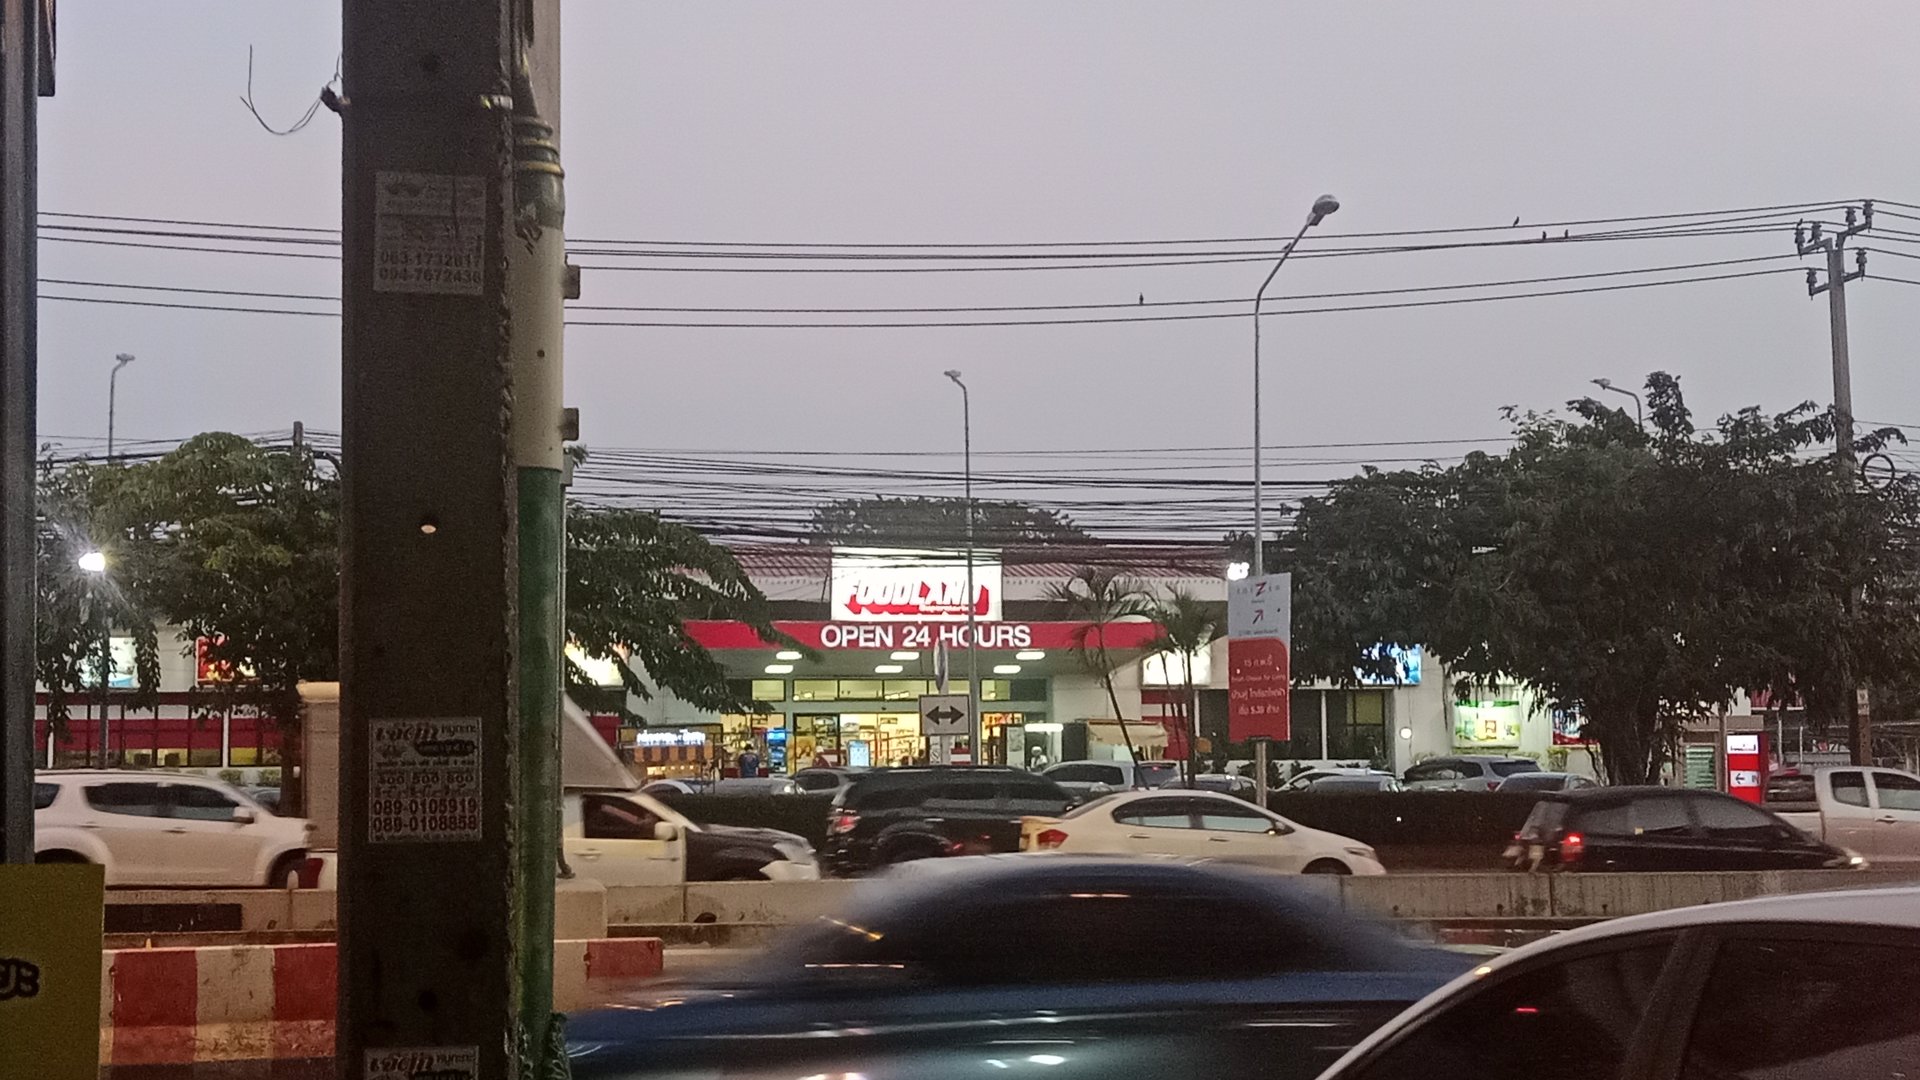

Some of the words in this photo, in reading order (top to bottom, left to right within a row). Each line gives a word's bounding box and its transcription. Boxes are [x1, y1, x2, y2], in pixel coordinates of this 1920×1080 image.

[847, 580, 989, 615] FOODLAND
[820, 625, 893, 648] OPEN
[902, 625, 931, 647] 24
[939, 625, 1031, 647] HOURS
[373, 798, 477, 815] 089-0105919
